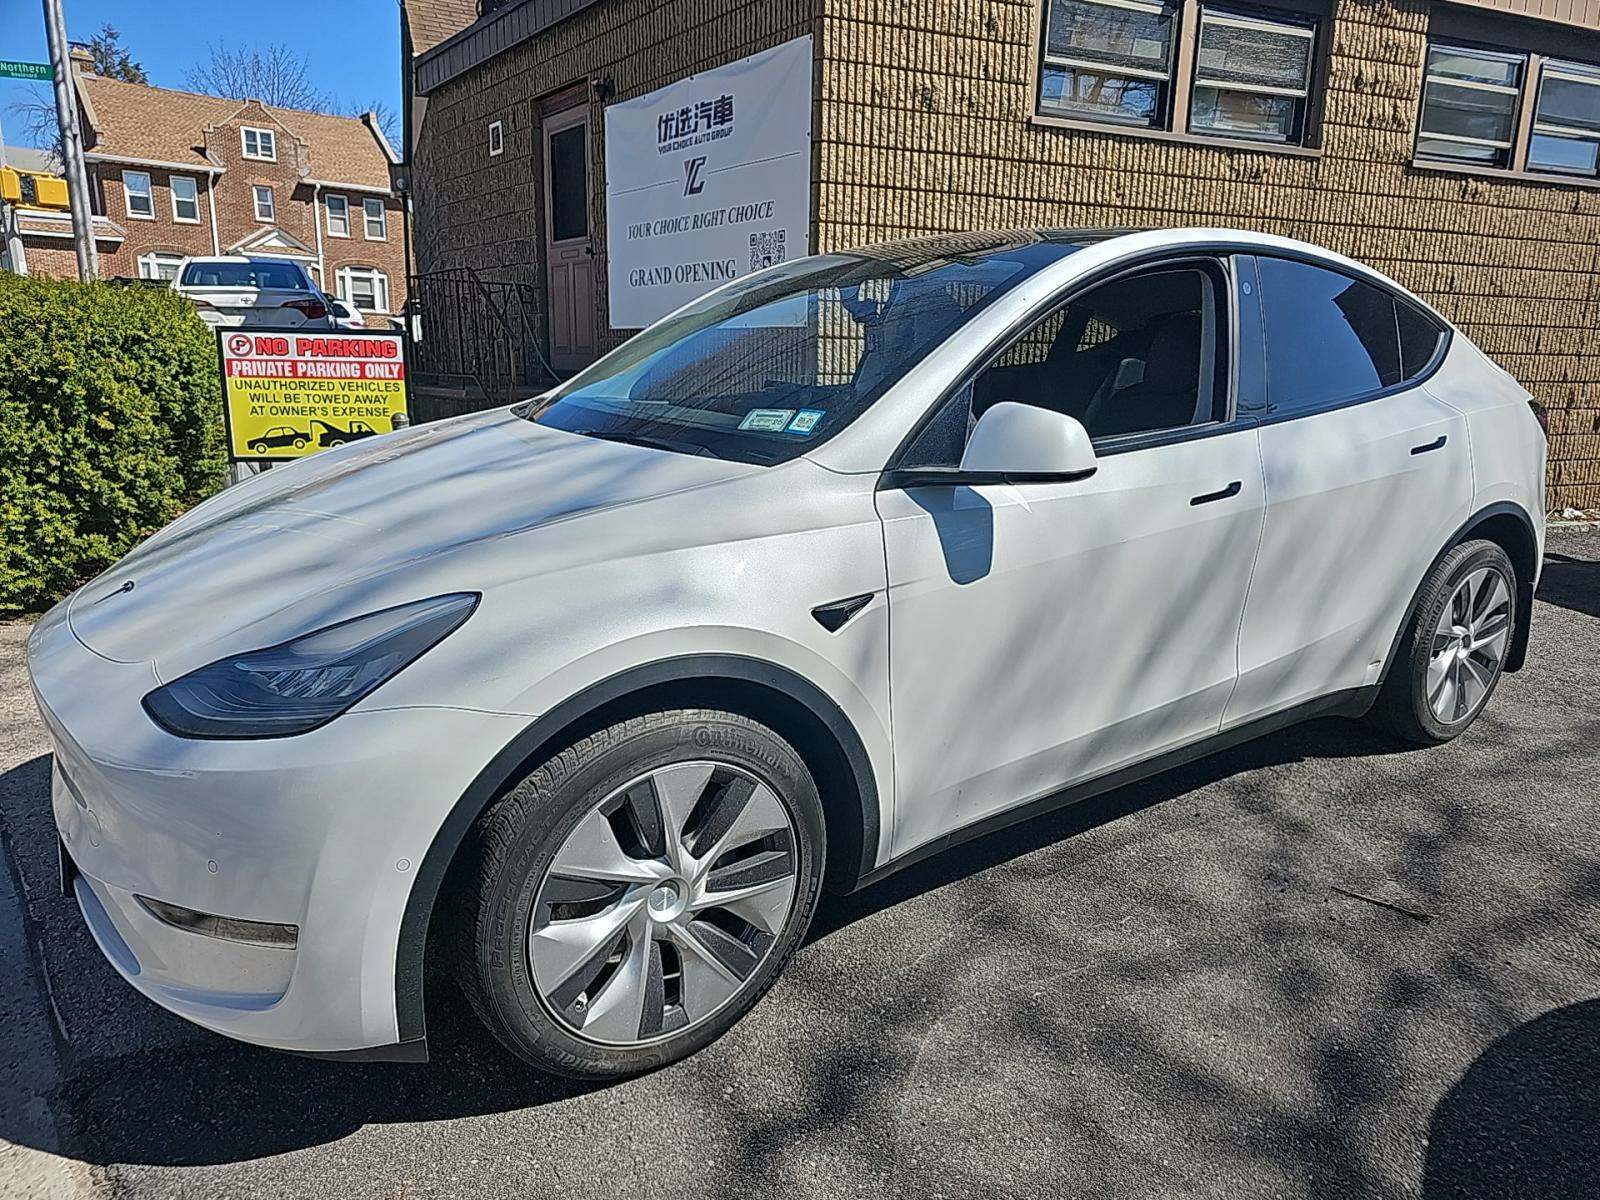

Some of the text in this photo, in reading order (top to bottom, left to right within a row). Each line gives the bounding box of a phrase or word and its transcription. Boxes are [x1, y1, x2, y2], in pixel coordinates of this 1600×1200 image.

[0, 62, 47, 74] Northern
[657, 95, 734, 144] 优选汽車
[658, 126, 734, 155] YOUR CHOICE AUTO GROUP
[628, 201, 775, 240] YOUR CHOICE RIGHT CHOICE
[629, 259, 736, 288] GRAND OPENING
[255, 337, 289, 356] NO
[296, 338, 398, 358] PARKING
[232, 360, 400, 379] PRIVATE PARKING ONLY
[235, 380, 400, 392] UNAUTHORIZED VEHICLES
[249, 393, 389, 405] WILL BE TOWED AWAY
[250, 405, 390, 418] AT OWNER'S EXPENSE
